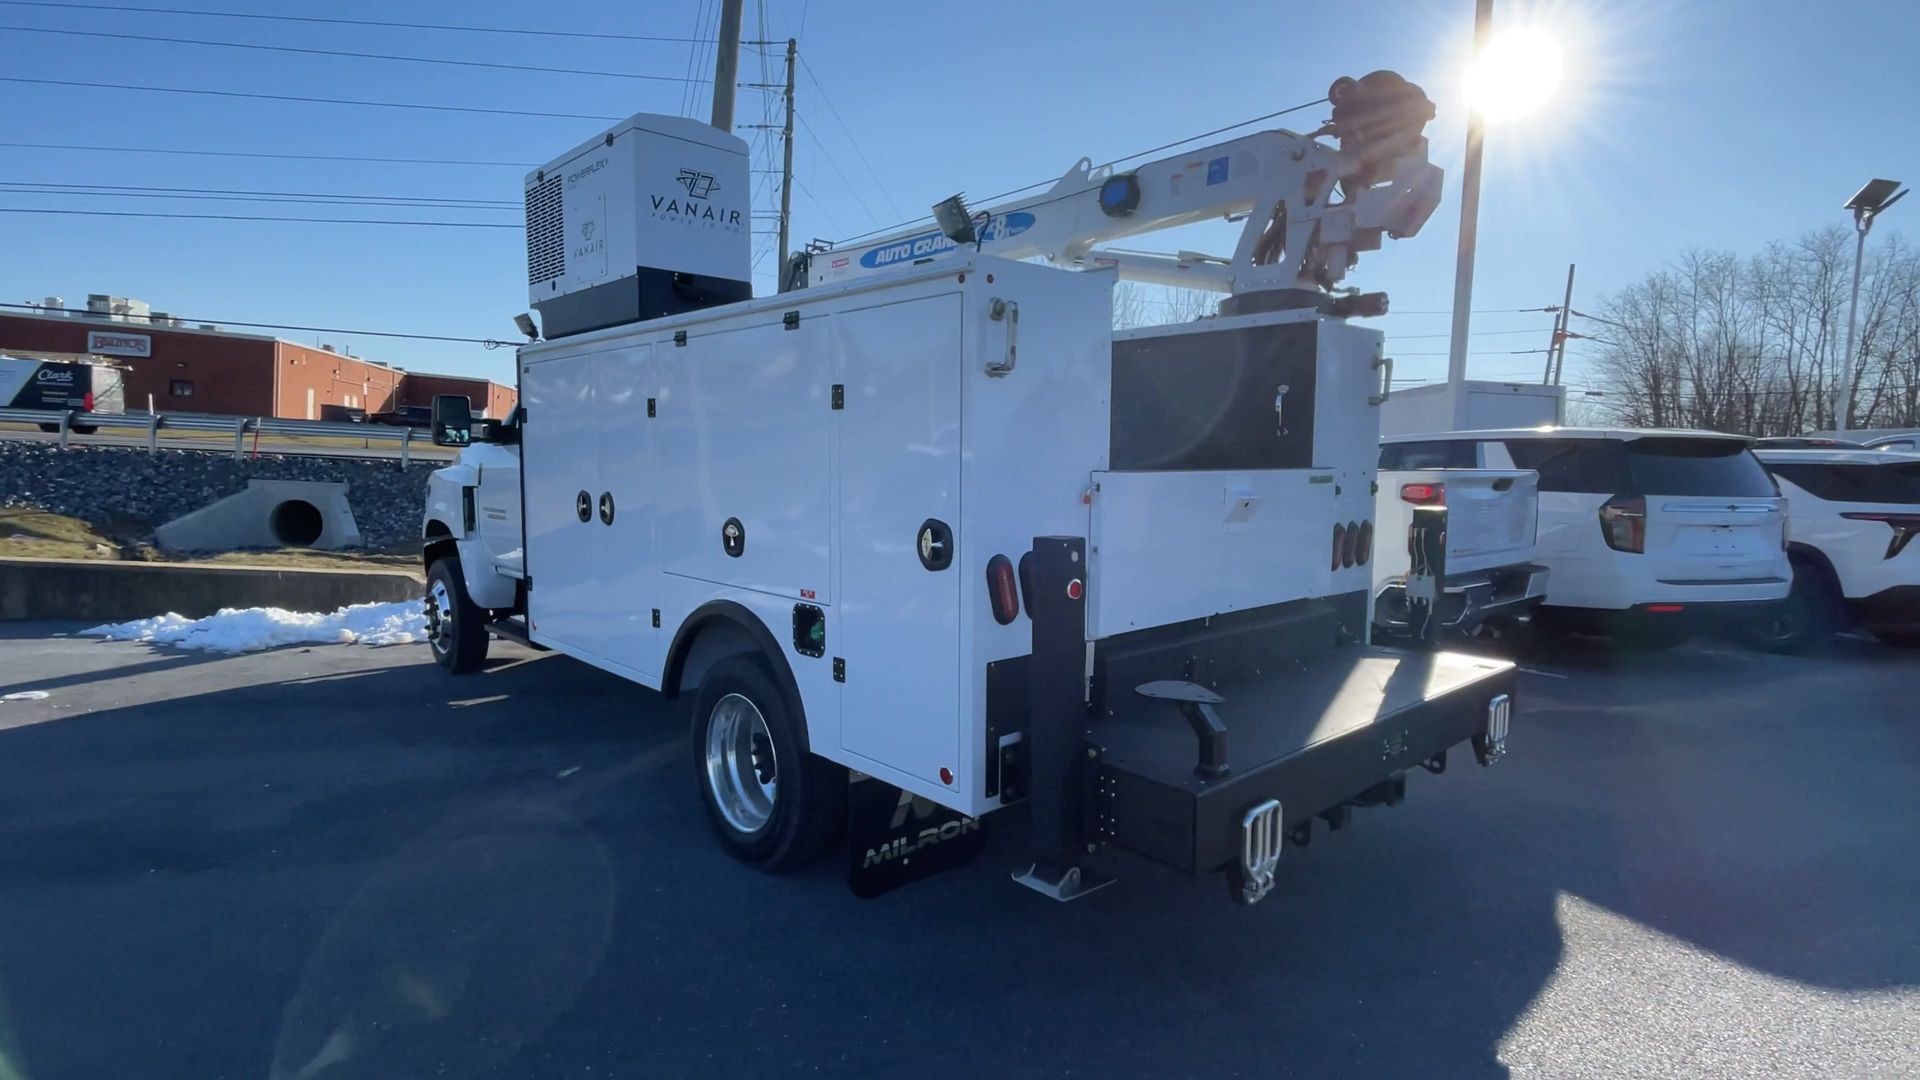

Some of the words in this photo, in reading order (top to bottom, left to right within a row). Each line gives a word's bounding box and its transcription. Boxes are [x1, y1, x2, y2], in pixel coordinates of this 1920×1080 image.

[650, 194, 741, 225] VANAIR
[874, 244, 912, 265] AUTO
[913, 232, 957, 256] CRAN
[37, 368, 74, 381] Clark
[863, 816, 980, 868] MILRON
